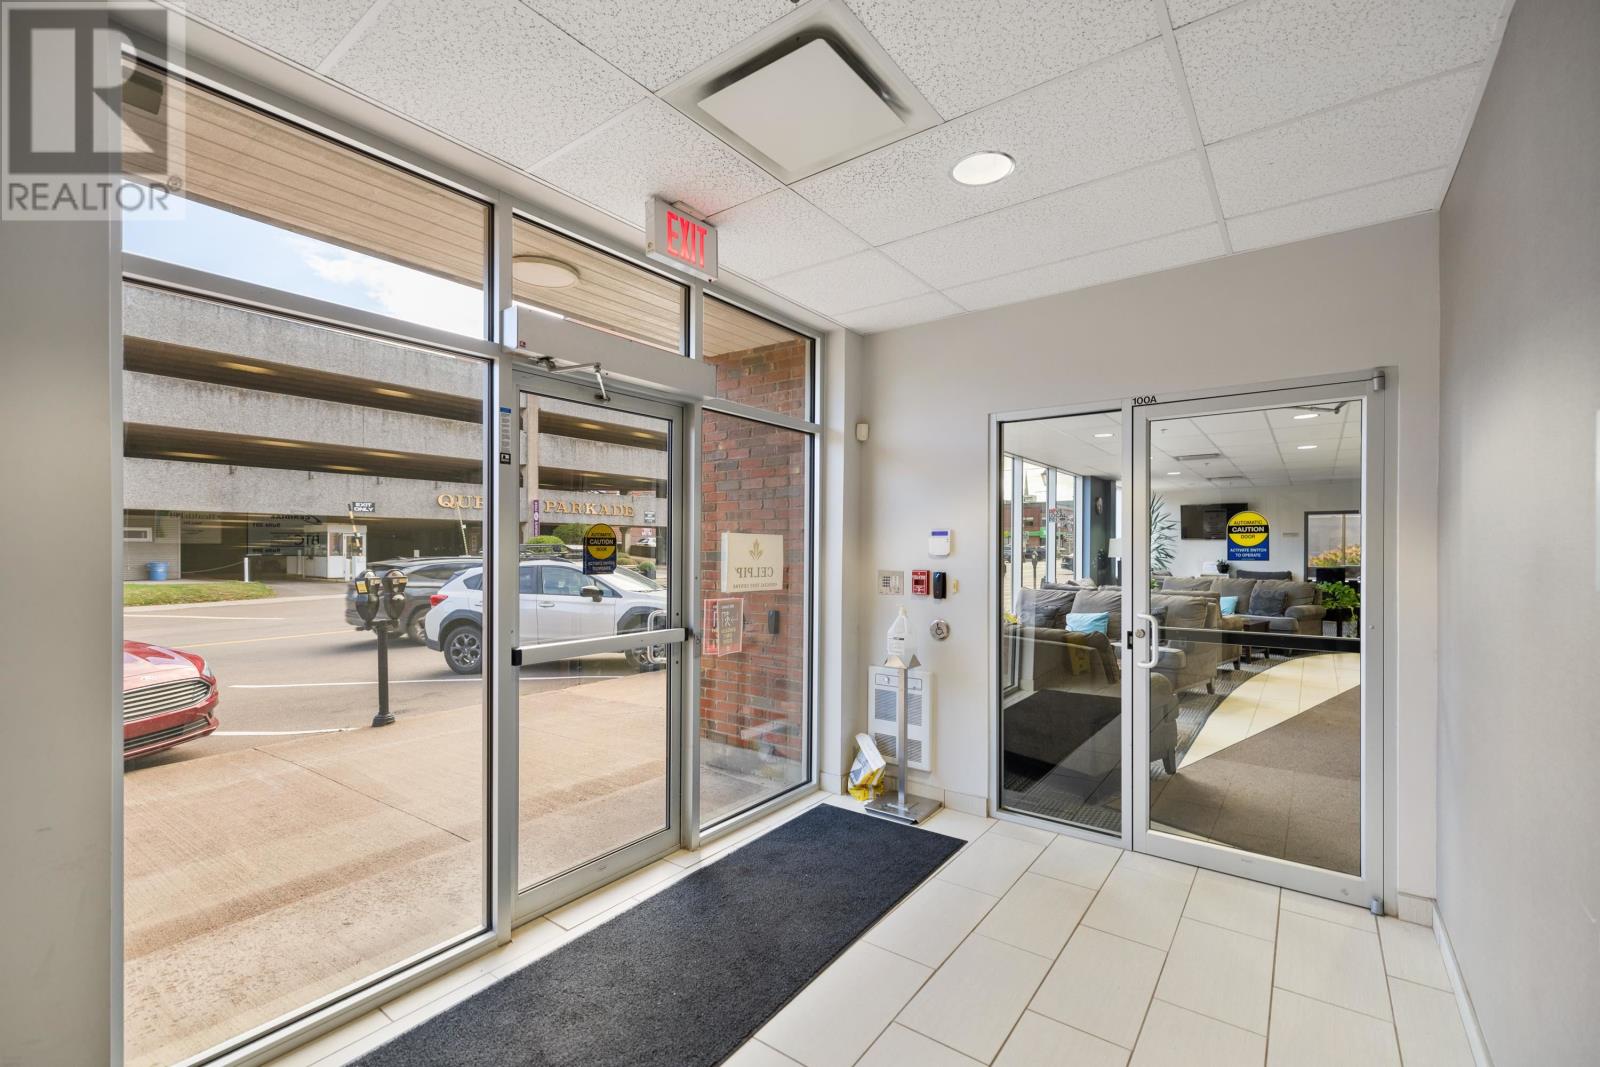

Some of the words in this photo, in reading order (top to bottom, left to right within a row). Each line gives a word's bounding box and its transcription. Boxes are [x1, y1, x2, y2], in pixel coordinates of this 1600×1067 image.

[666, 210, 707, 268] EXIT
[1132, 395, 1157, 405] 100A
[437, 494, 483, 509] QUE
[544, 500, 634, 517] PARKADE
